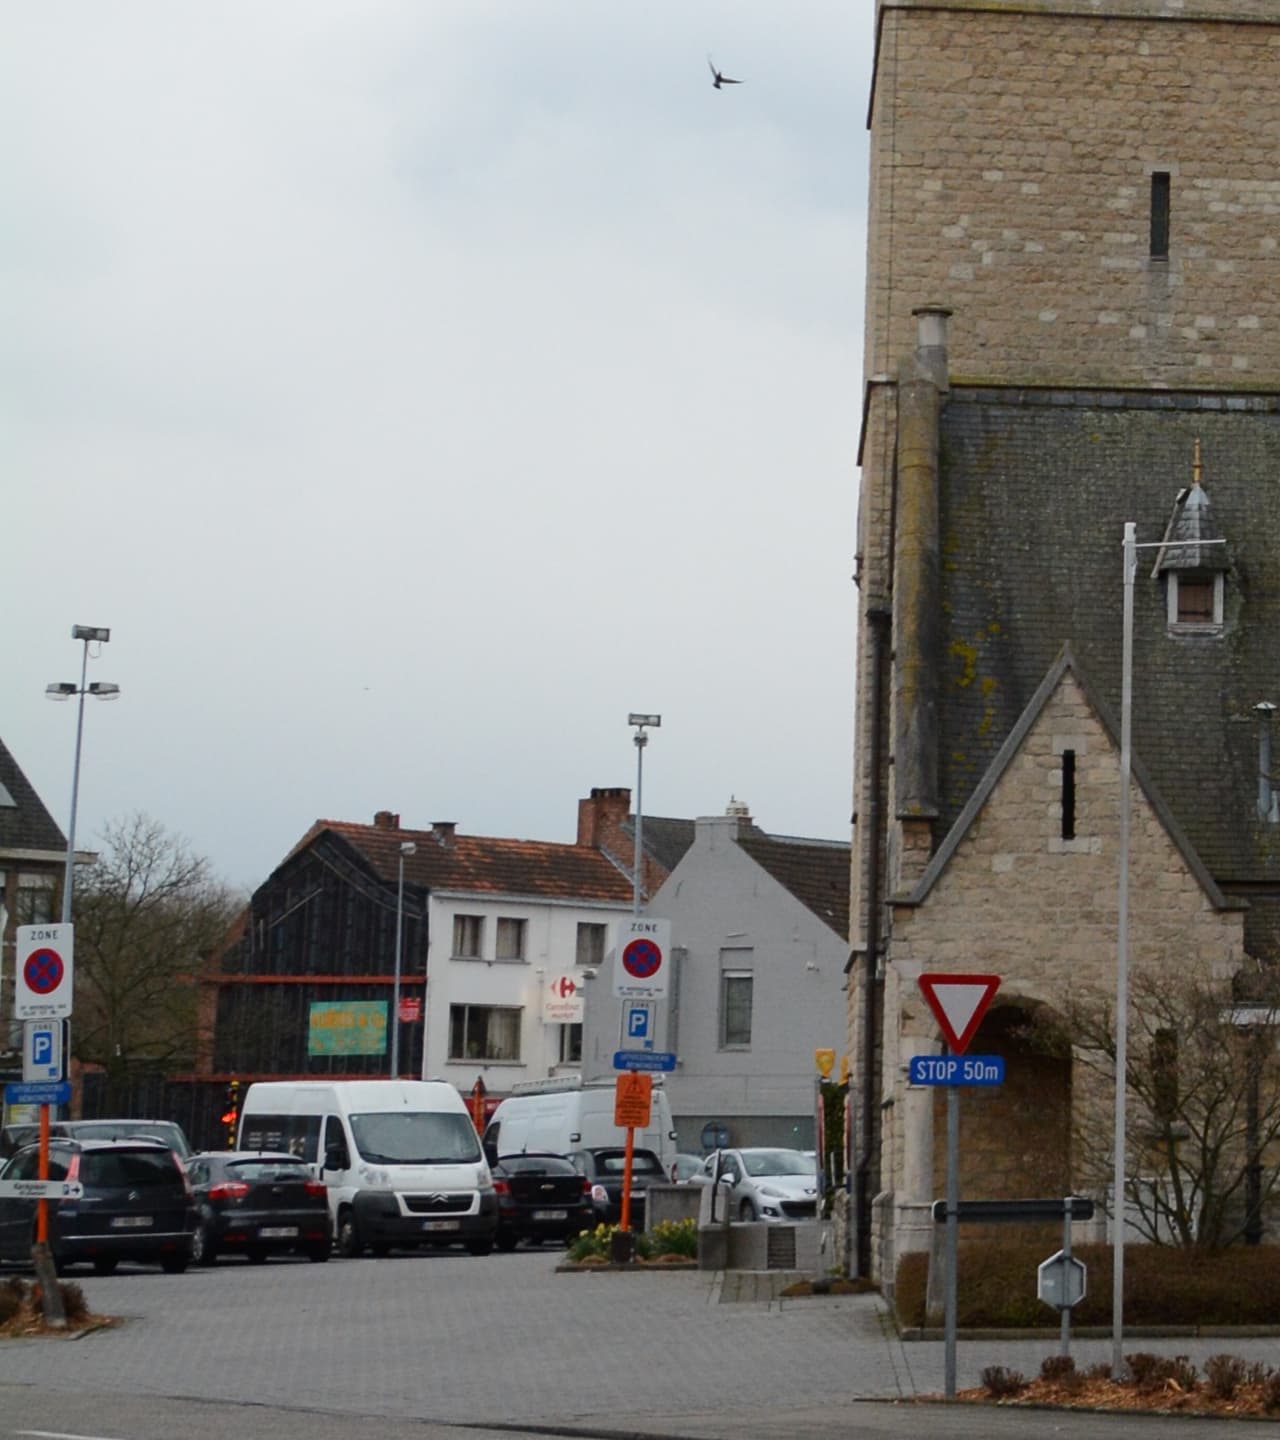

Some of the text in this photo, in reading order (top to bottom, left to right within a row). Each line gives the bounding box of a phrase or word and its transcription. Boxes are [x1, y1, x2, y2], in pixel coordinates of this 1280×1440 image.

[31, 930, 58, 940] ZONE
[630, 923, 657, 932] ZONE
[631, 1014, 646, 1033] P
[35, 1037, 50, 1061] P
[917, 1061, 998, 1080] STOP 50m
